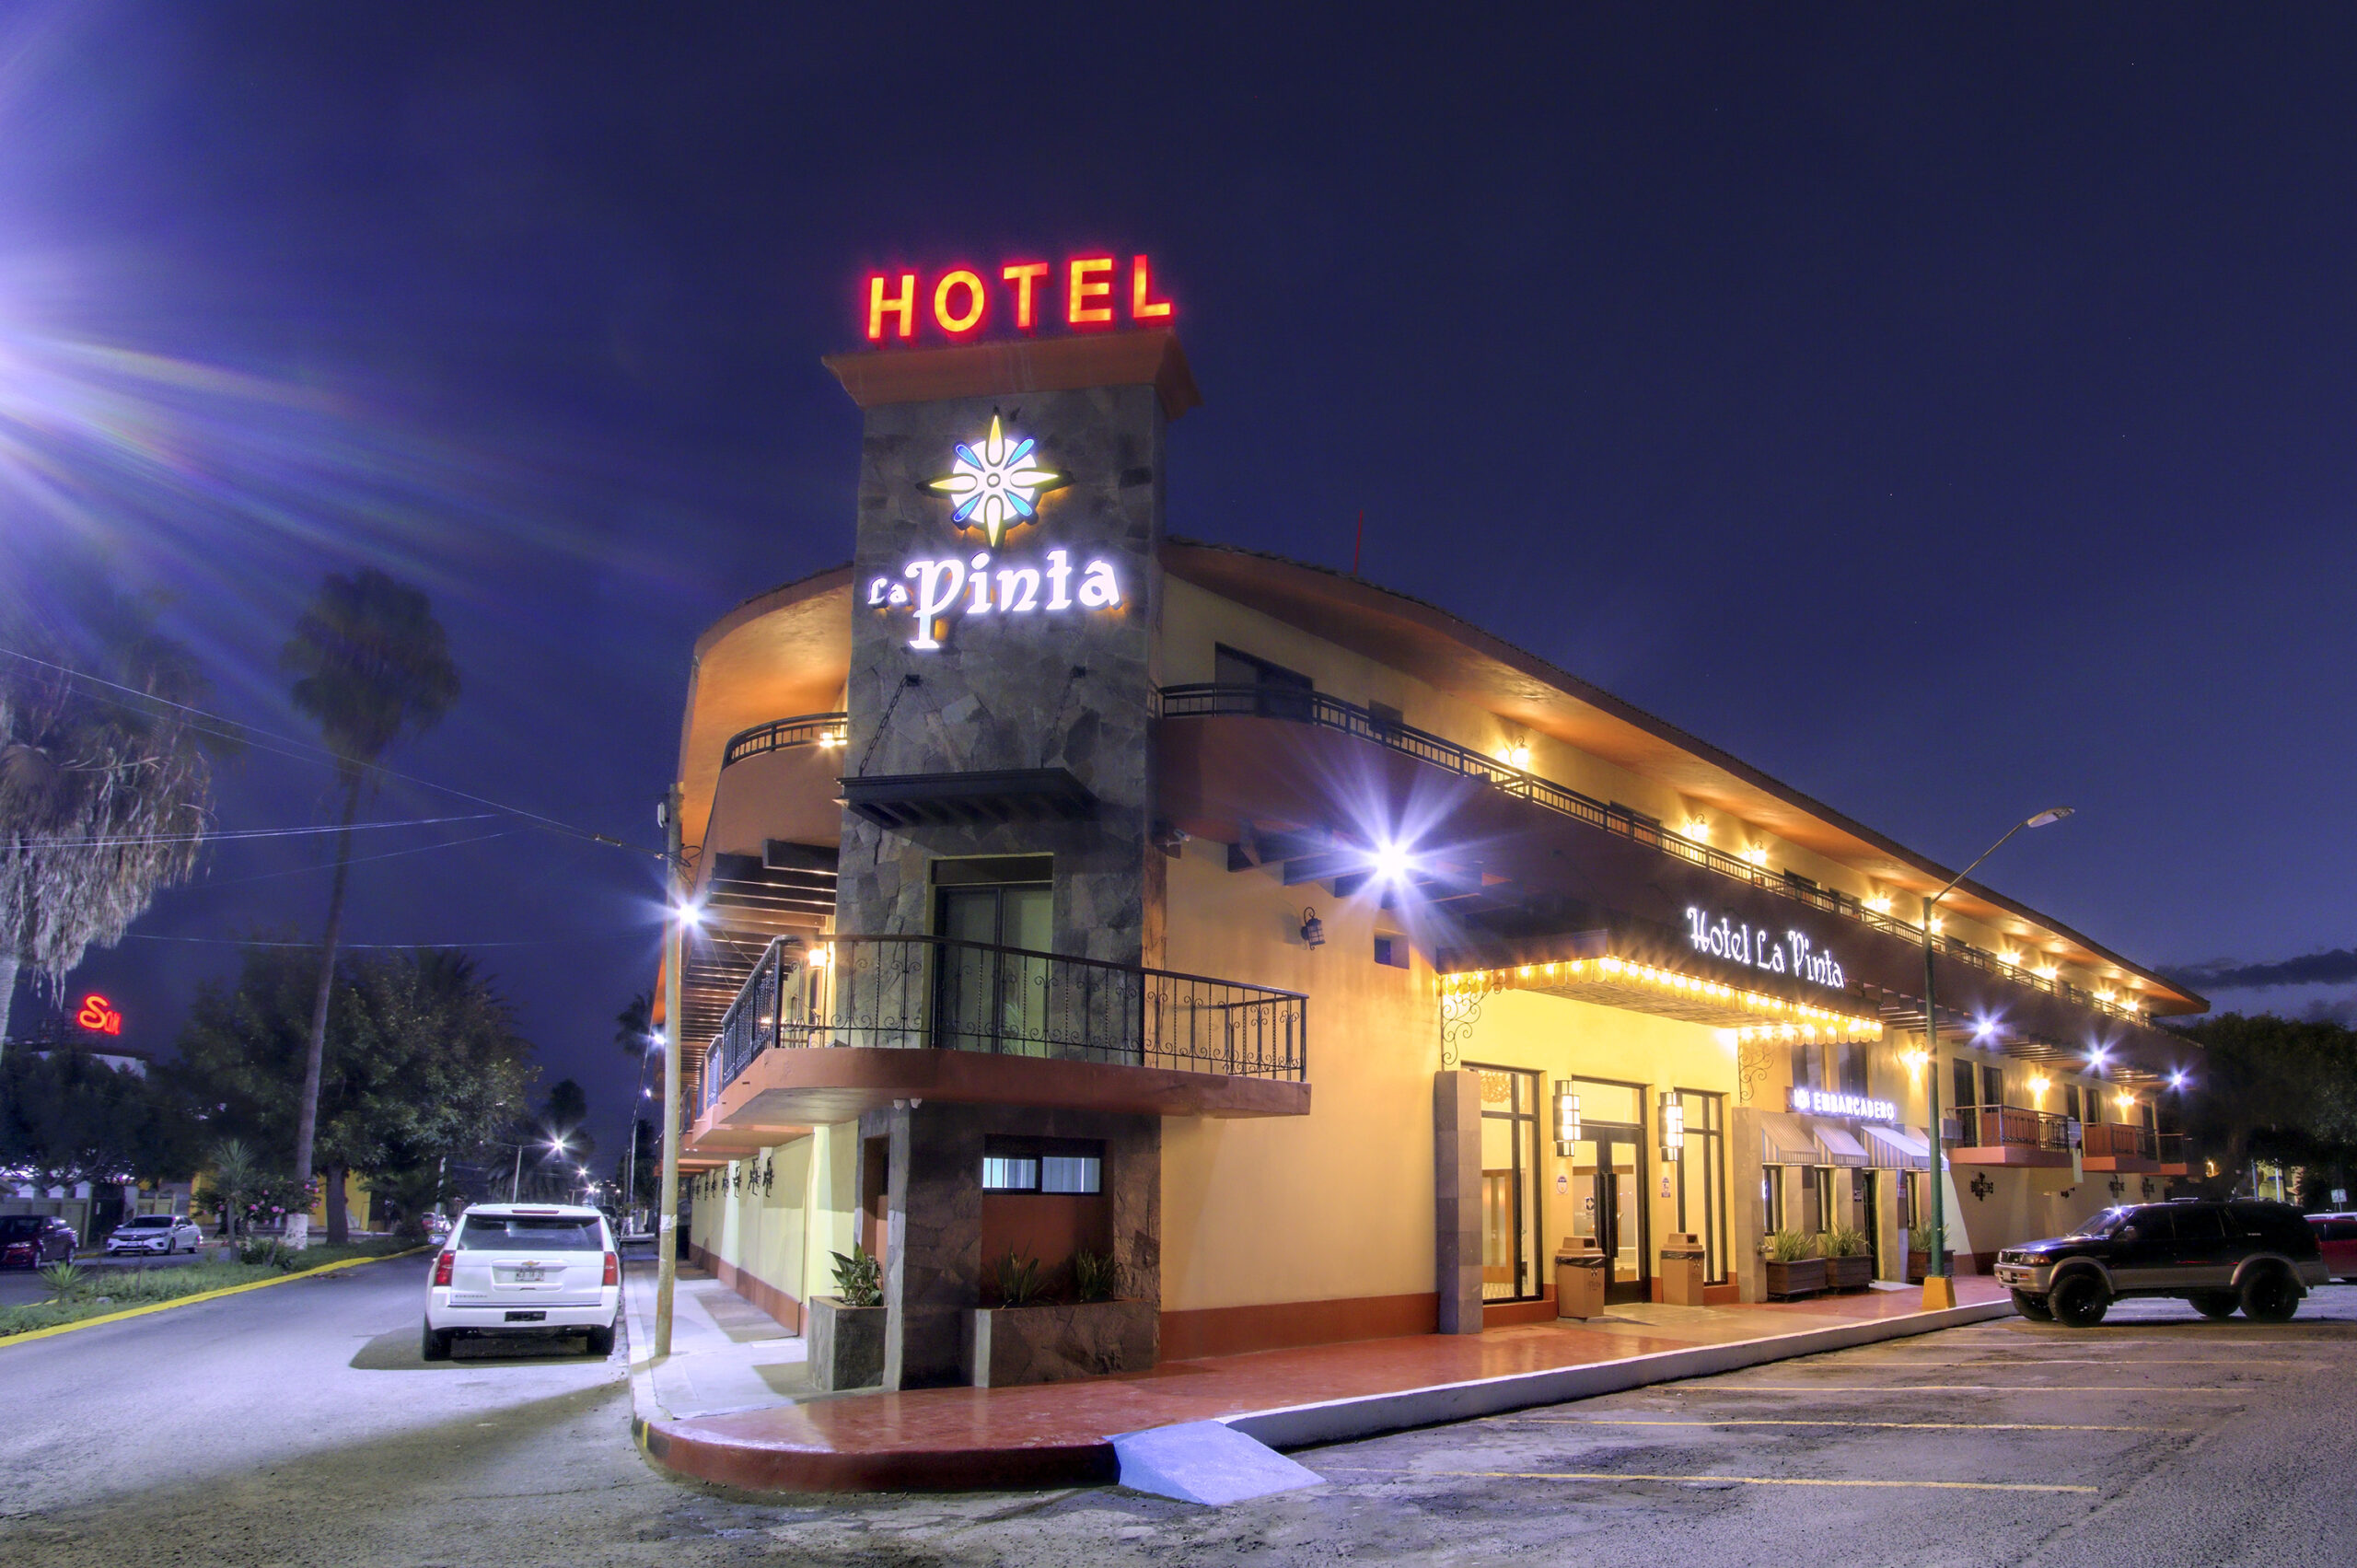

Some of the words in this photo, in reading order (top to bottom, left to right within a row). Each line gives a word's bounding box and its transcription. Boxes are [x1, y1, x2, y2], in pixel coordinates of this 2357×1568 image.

[867, 254, 1171, 339] HOTEL
[867, 577, 910, 605] La
[904, 550, 1120, 649] Pinta
[1687, 907, 1751, 965] Hotel
[1757, 930, 1785, 973] La
[1788, 930, 1845, 989] Pinta
[1812, 1091, 1896, 1121] EMBARCADERO
